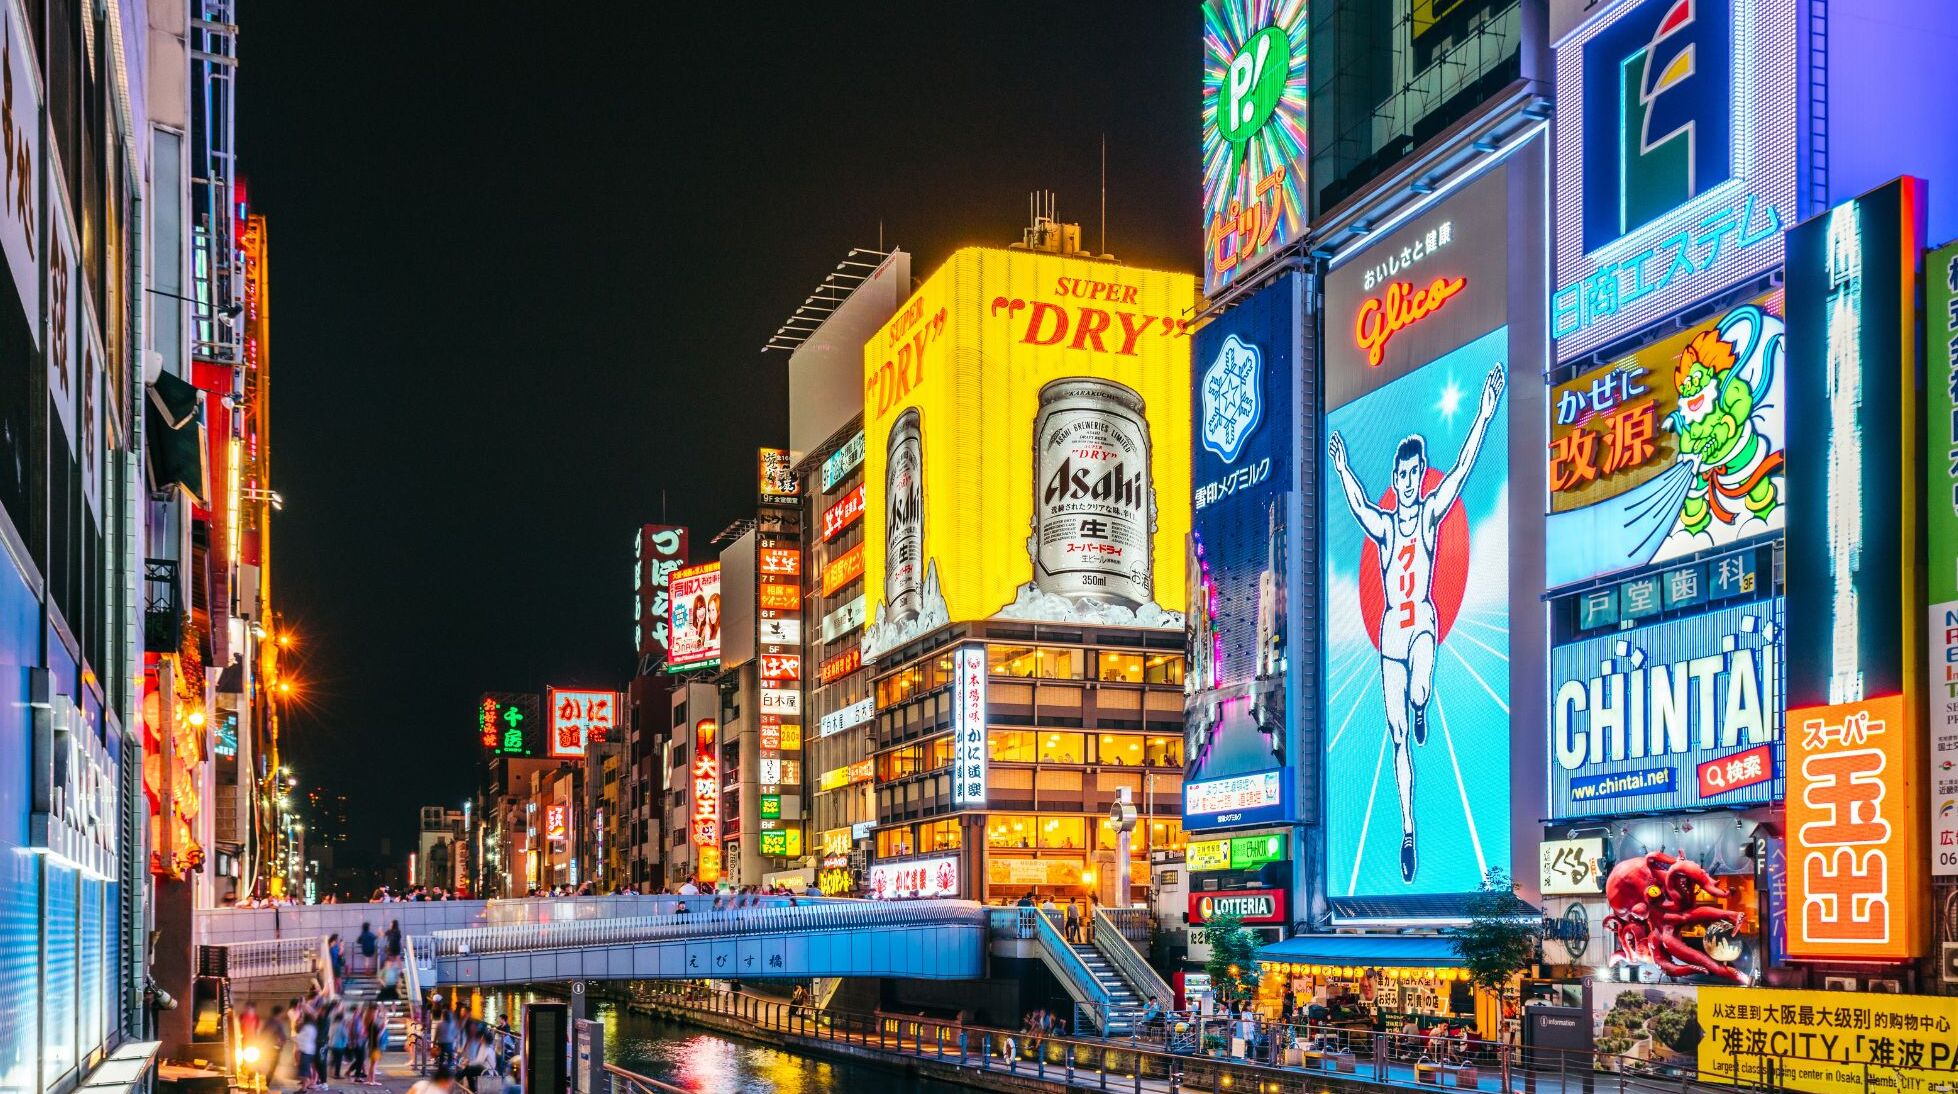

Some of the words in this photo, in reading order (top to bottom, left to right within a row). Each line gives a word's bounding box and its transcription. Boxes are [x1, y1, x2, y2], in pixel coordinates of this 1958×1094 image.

[1214, 165, 1287, 273] ピップ
[1363, 222, 1452, 290] おいしさと健康
[1553, 194, 1780, 338] 日商エステム
[1055, 276, 1138, 305] SUPER
[888, 296, 924, 348] SUPER
[1356, 277, 1466, 366] Glico
[1557, 368, 1646, 424] かぜに
[1056, 429, 1071, 446] ASAHI
[1073, 420, 1109, 433] BREWERIES
[1111, 430, 1131, 453] LIMITED
[1548, 399, 1657, 492] 改源
[1044, 457, 1141, 511] Asahi
[1195, 458, 1270, 510] 雪印メグミルク
[889, 488, 919, 543] Asahi
[1080, 519, 1108, 539] 生
[1066, 543, 1123, 557] スーパードライ
[1082, 575, 1107, 586] 350ml
[1398, 538, 1416, 629] グリコ
[762, 658, 798, 677] はや
[559, 696, 608, 721] かに
[763, 693, 796, 707] 白木屋
[967, 673, 981, 722] 本場の味
[1555, 622, 1779, 769] CHINTAI
[1802, 710, 1885, 750] スーパー
[1727, 755, 1762, 784] 検索
[1799, 748, 1891, 943] 玉出
[1551, 847, 1589, 885] くくる
[1214, 897, 1267, 914] LOTTERIA
[689, 954, 783, 968] えびす橋
[1549, 1018, 1575, 1027] information
[1799, 1068, 1823, 1081] center
[1826, 1069, 1833, 1081] in
